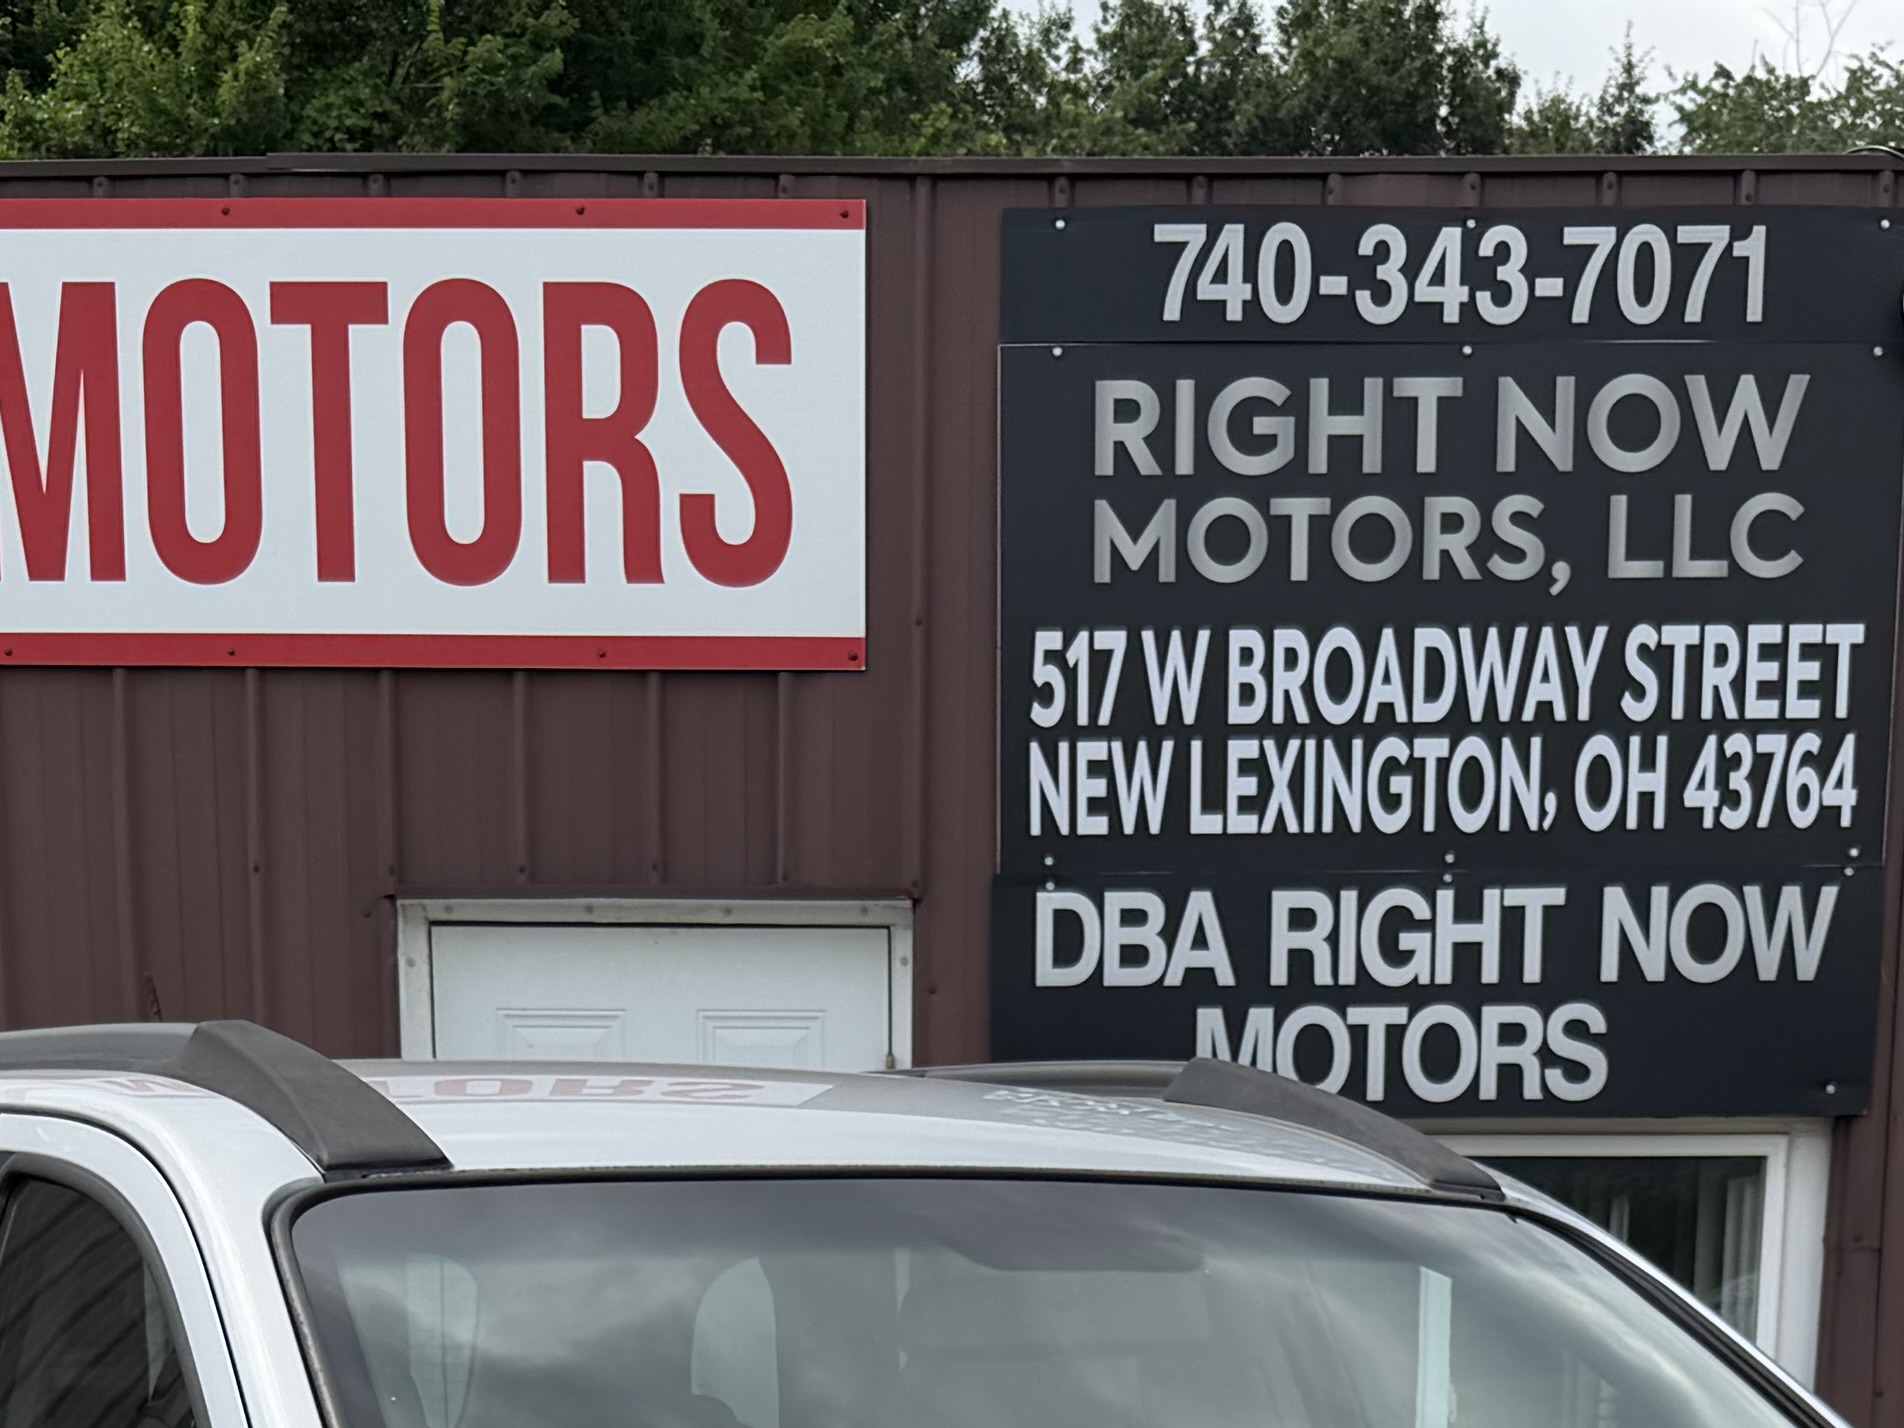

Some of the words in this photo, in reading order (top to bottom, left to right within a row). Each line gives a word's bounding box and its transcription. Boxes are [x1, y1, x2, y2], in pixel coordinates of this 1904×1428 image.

[1153, 221, 1768, 326] 740-343-7071
[1094, 376, 1464, 476] RIGHT
[1496, 373, 1810, 473] NOW
[1094, 494, 1571, 596] MOTORS,
[1607, 492, 1805, 579] LLC
[1031, 630, 1128, 728] 517
[1141, 629, 1210, 726] W
[1228, 625, 1609, 725] BROADWAY
[1621, 623, 1866, 722] STREET
[1029, 739, 1175, 836] NEW
[1189, 735, 1557, 835] LEXINGTON,
[1574, 734, 1668, 832] OH
[1683, 731, 1858, 830] 43764
[1035, 889, 1236, 988] DBA
[1269, 886, 1567, 988] RIGHT
[1600, 883, 1840, 984] NOW
[1196, 1002, 1609, 1103] MOTORS
